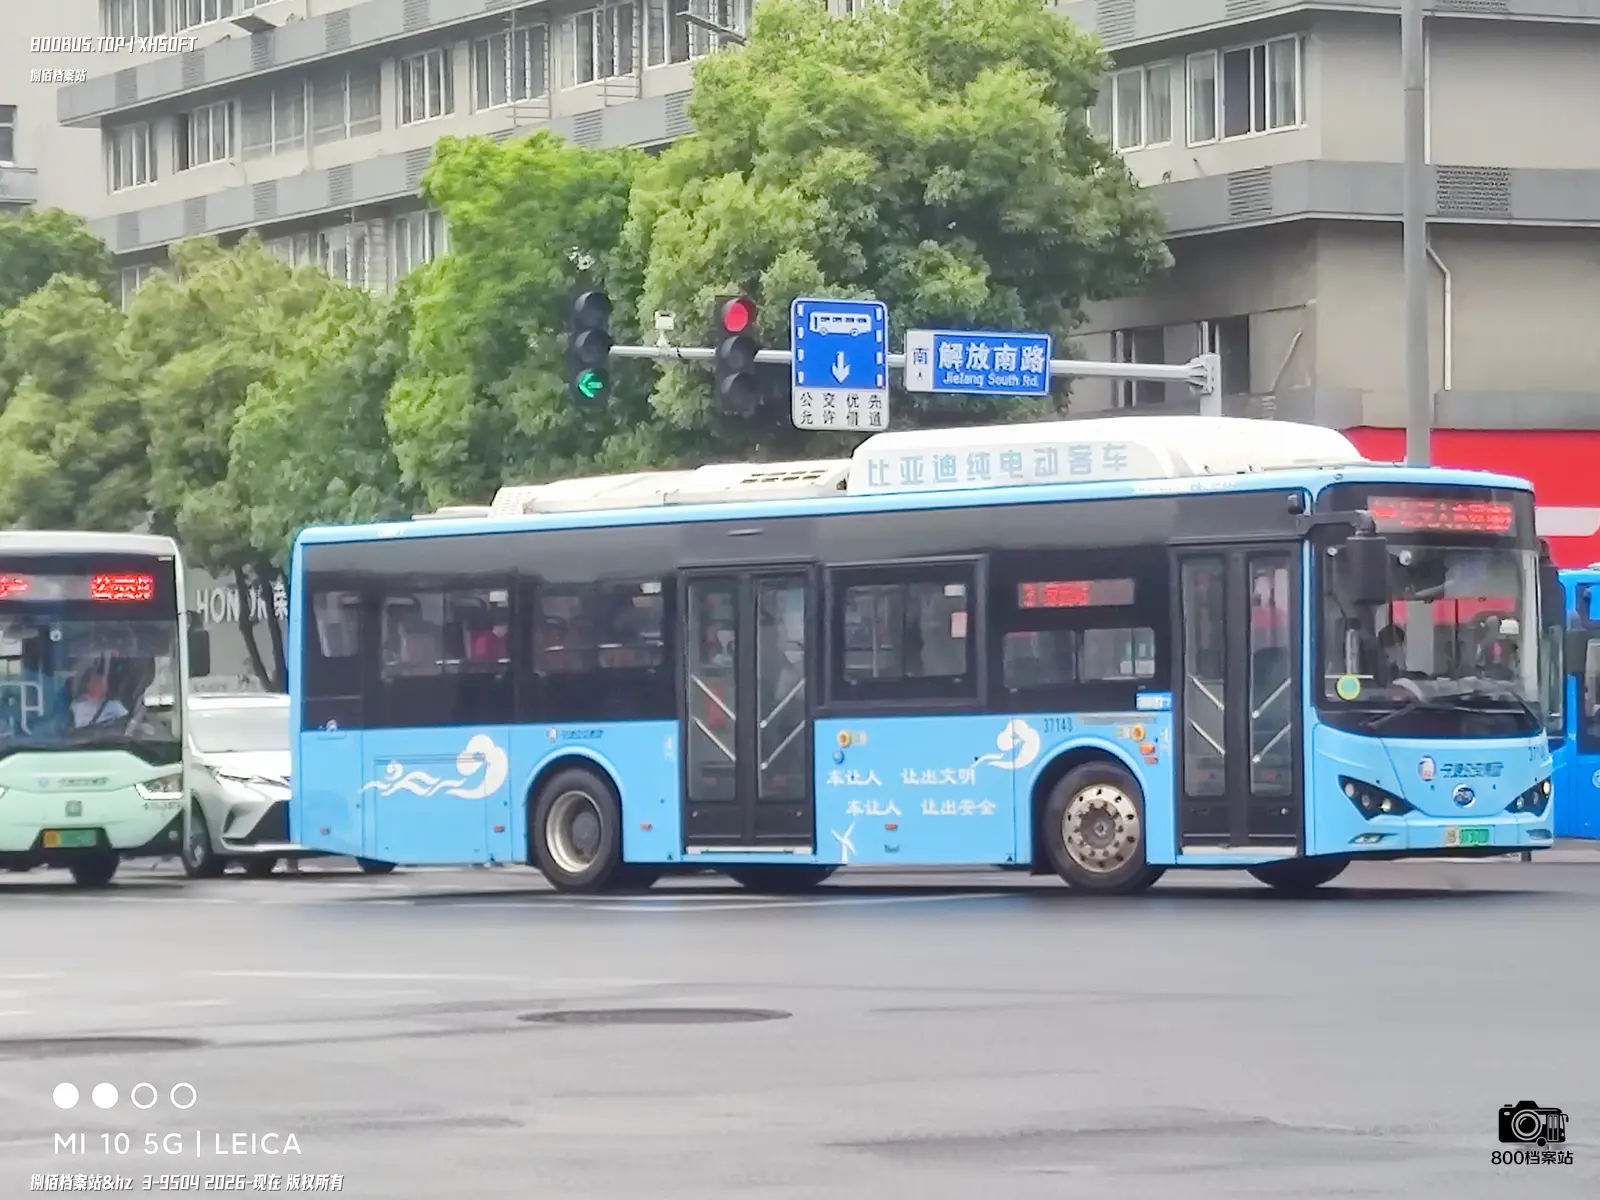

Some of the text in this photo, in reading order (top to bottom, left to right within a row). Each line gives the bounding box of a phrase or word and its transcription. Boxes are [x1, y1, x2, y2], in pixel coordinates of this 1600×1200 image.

[912, 346, 929, 364] 南
[938, 341, 1044, 373] 解放南路
[987, 373, 1019, 387] South
[800, 391, 882, 409] 公交优先
[867, 443, 1128, 487] 比亚迪纯电动客车
[901, 768, 976, 785] 让出文明
[921, 799, 997, 816] 让出安全
